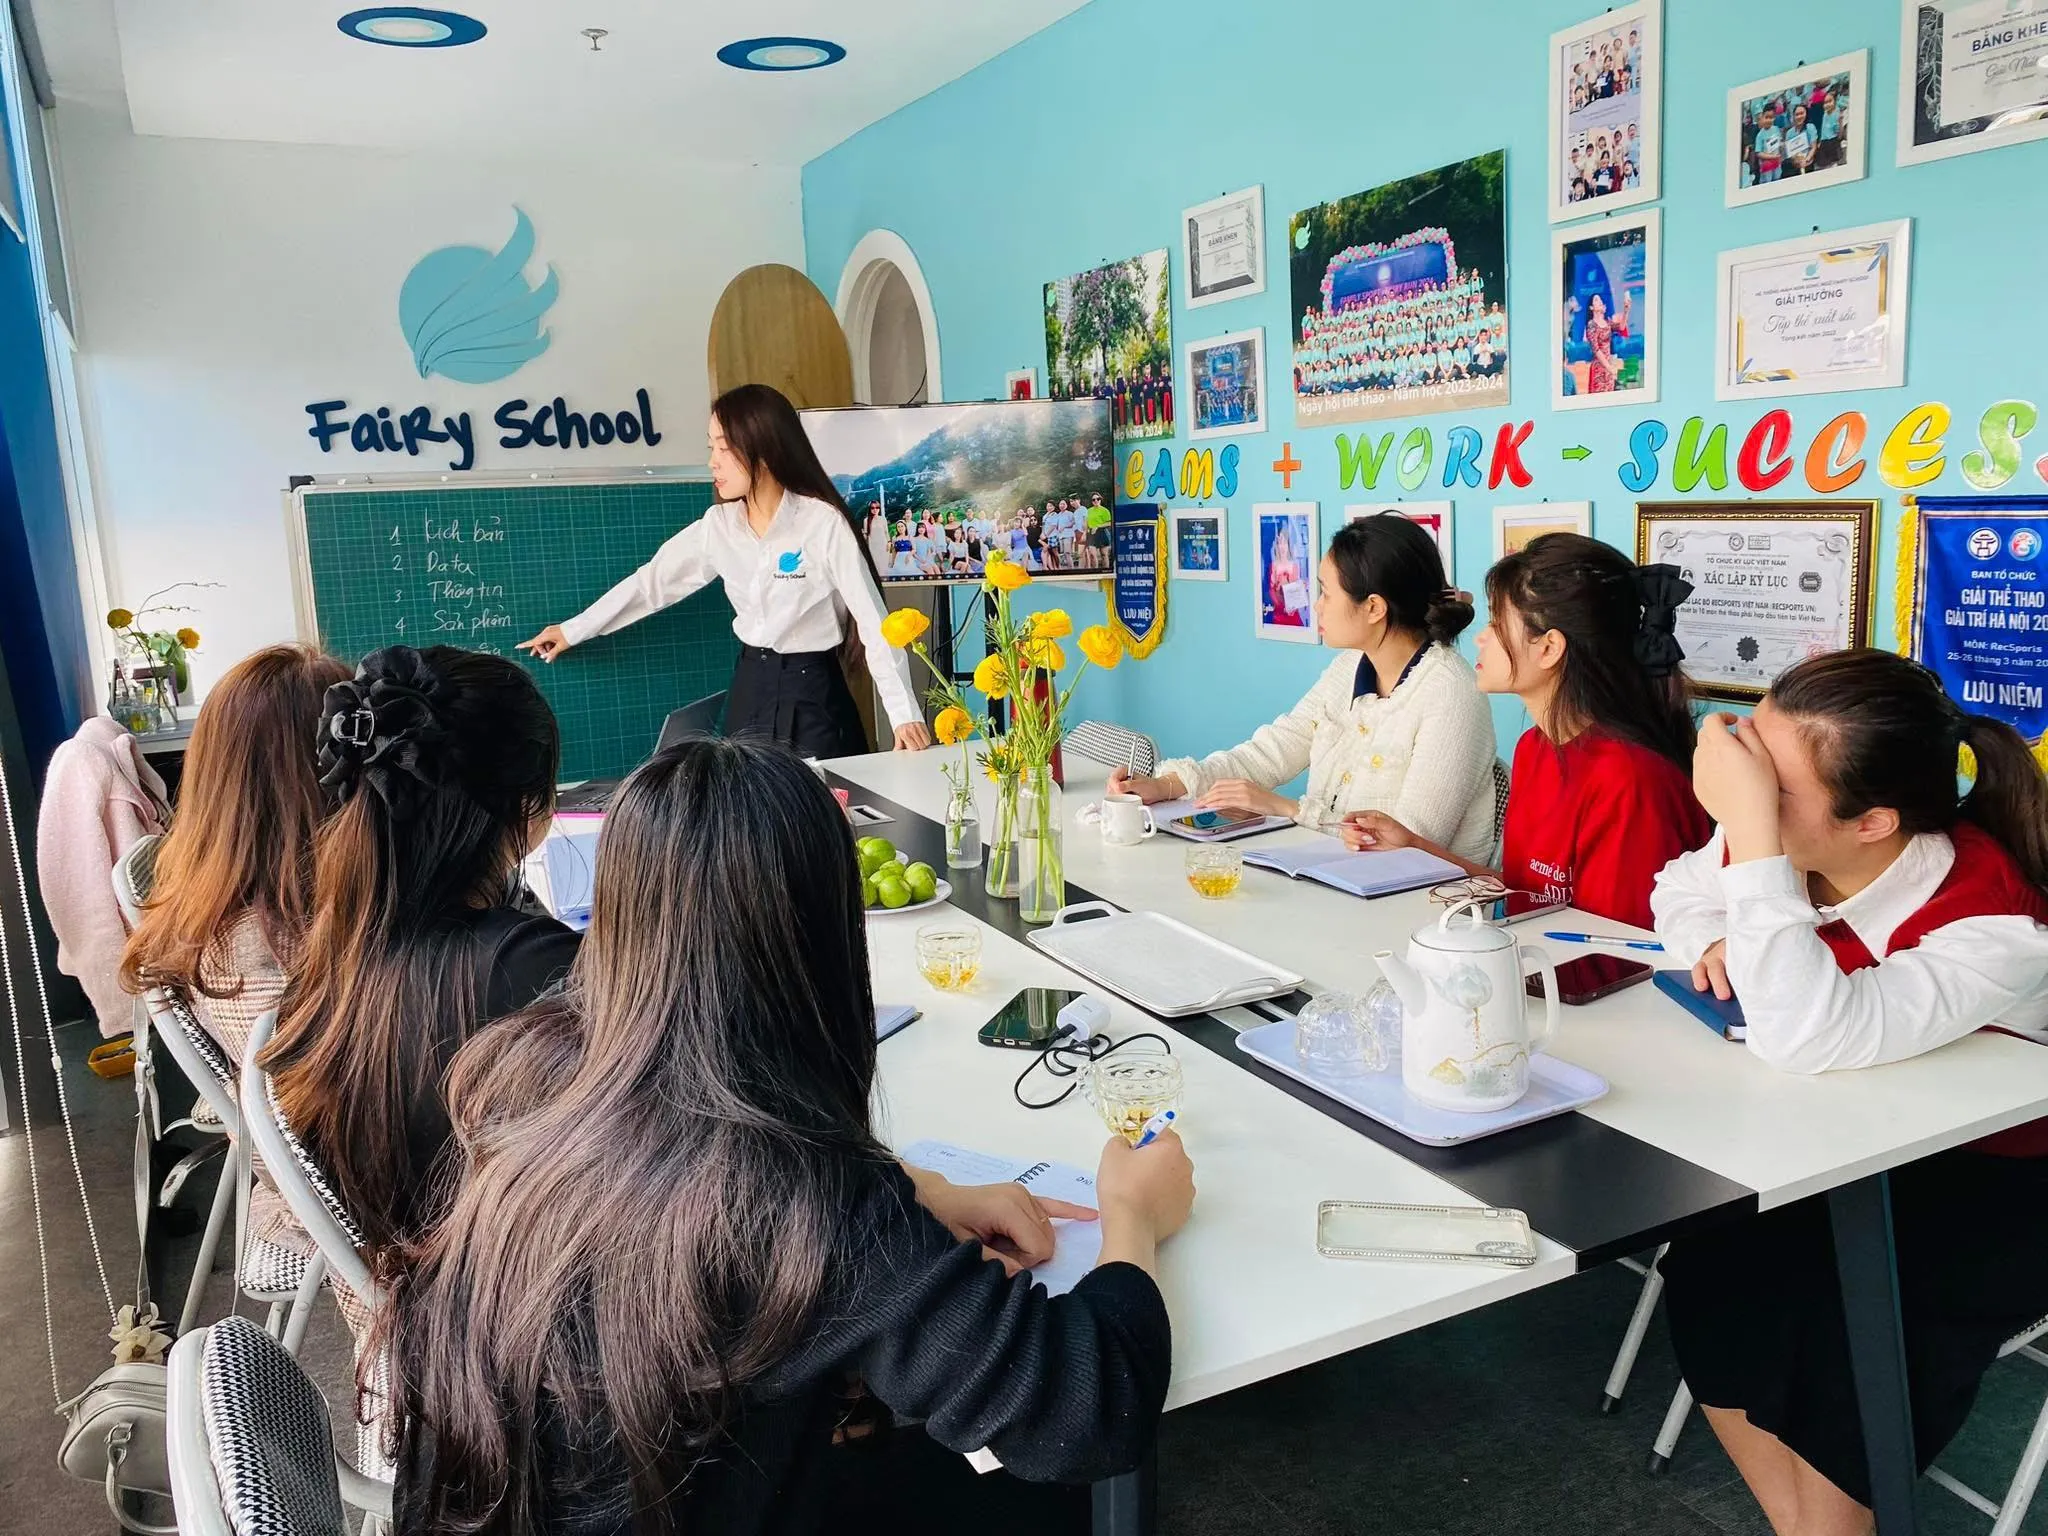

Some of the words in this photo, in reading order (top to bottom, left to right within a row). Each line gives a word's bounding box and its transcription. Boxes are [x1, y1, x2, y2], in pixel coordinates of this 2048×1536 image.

[2017, 21, 2048, 40] KHE
[1361, 392, 1384, 406] thao
[1114, 444, 1240, 500] EAMS
[1334, 419, 1536, 492] WORK
[1617, 400, 2048, 494] SUCCES
[393, 554, 403, 571] 2
[427, 550, 476, 576] Data
[1971, 570, 1992, 580] BAN
[1993, 568, 2007, 580] TỔ
[2008, 569, 2037, 581] CHỨC
[394, 589, 402, 603] 3
[1961, 584, 1986, 606] GIẢI
[1988, 583, 2012, 607] THỂ
[2013, 591, 2045, 609] THAO
[395, 616, 406, 637] 4
[1967, 607, 1987, 628] TRÍ
[2033, 615, 2048, 632] 20
[2003, 657, 2010, 666] 3
[2012, 656, 2034, 667] năm
[2036, 658, 2048, 668] 20
[1963, 680, 1995, 704] LƯU
[1999, 681, 2043, 711] NIỆM
[1530, 858, 1555, 878] acmé
[1553, 865, 1566, 882] de
